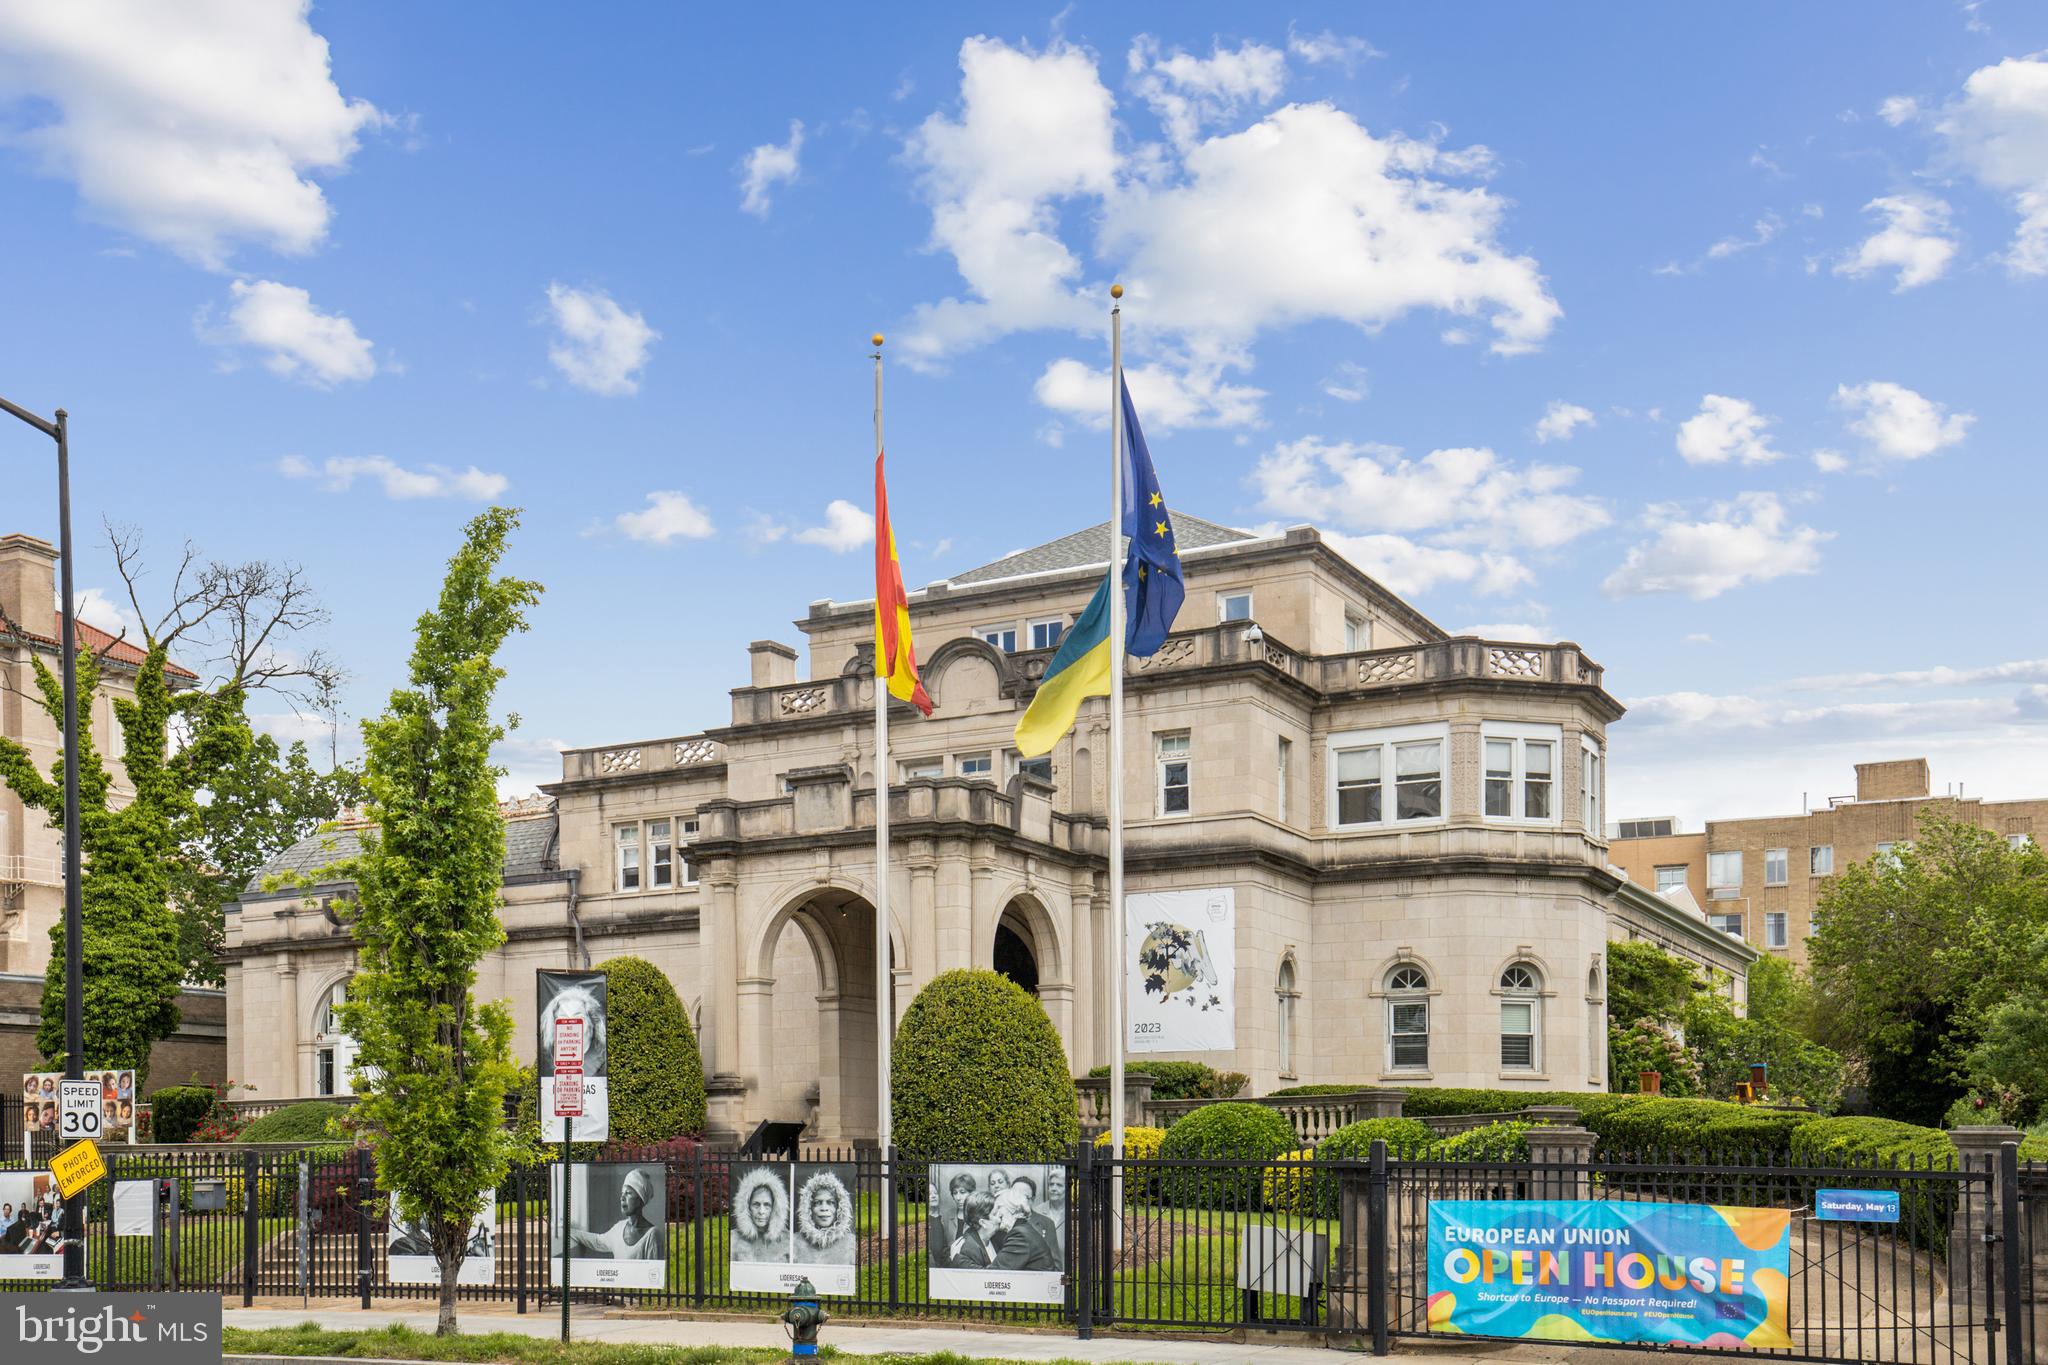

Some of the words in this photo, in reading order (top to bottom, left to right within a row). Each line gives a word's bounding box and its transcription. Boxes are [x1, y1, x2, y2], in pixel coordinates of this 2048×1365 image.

[1134, 1022, 1161, 1033] 2023
[63, 1087, 99, 1096] SPEED
[67, 1100, 95, 1108] LIMIT
[63, 1111, 99, 1133] 30
[62, 1150, 88, 1172] PHOTO
[60, 1158, 100, 1189] ENFORCED
[1821, 1201, 1864, 1213] Saturday,
[1865, 1203, 1884, 1213] May
[1886, 1204, 1896, 1213] 13
[1444, 1226, 1555, 1245] EUROPEAN
[1563, 1228, 1631, 1246] UNION
[1443, 1247, 1570, 1286] OPEN
[1583, 1251, 1745, 1295] HOUSE
[984, 1281, 1011, 1290] LIDERESAS
[1477, 1292, 1519, 1302] Shortcut
[1520, 1293, 1531, 1302] to
[1534, 1293, 1570, 1304] Europe
[1584, 1296, 1599, 1305] No
[1602, 1296, 1645, 1307] Passport
[1648, 1298, 1697, 1309] Required!
